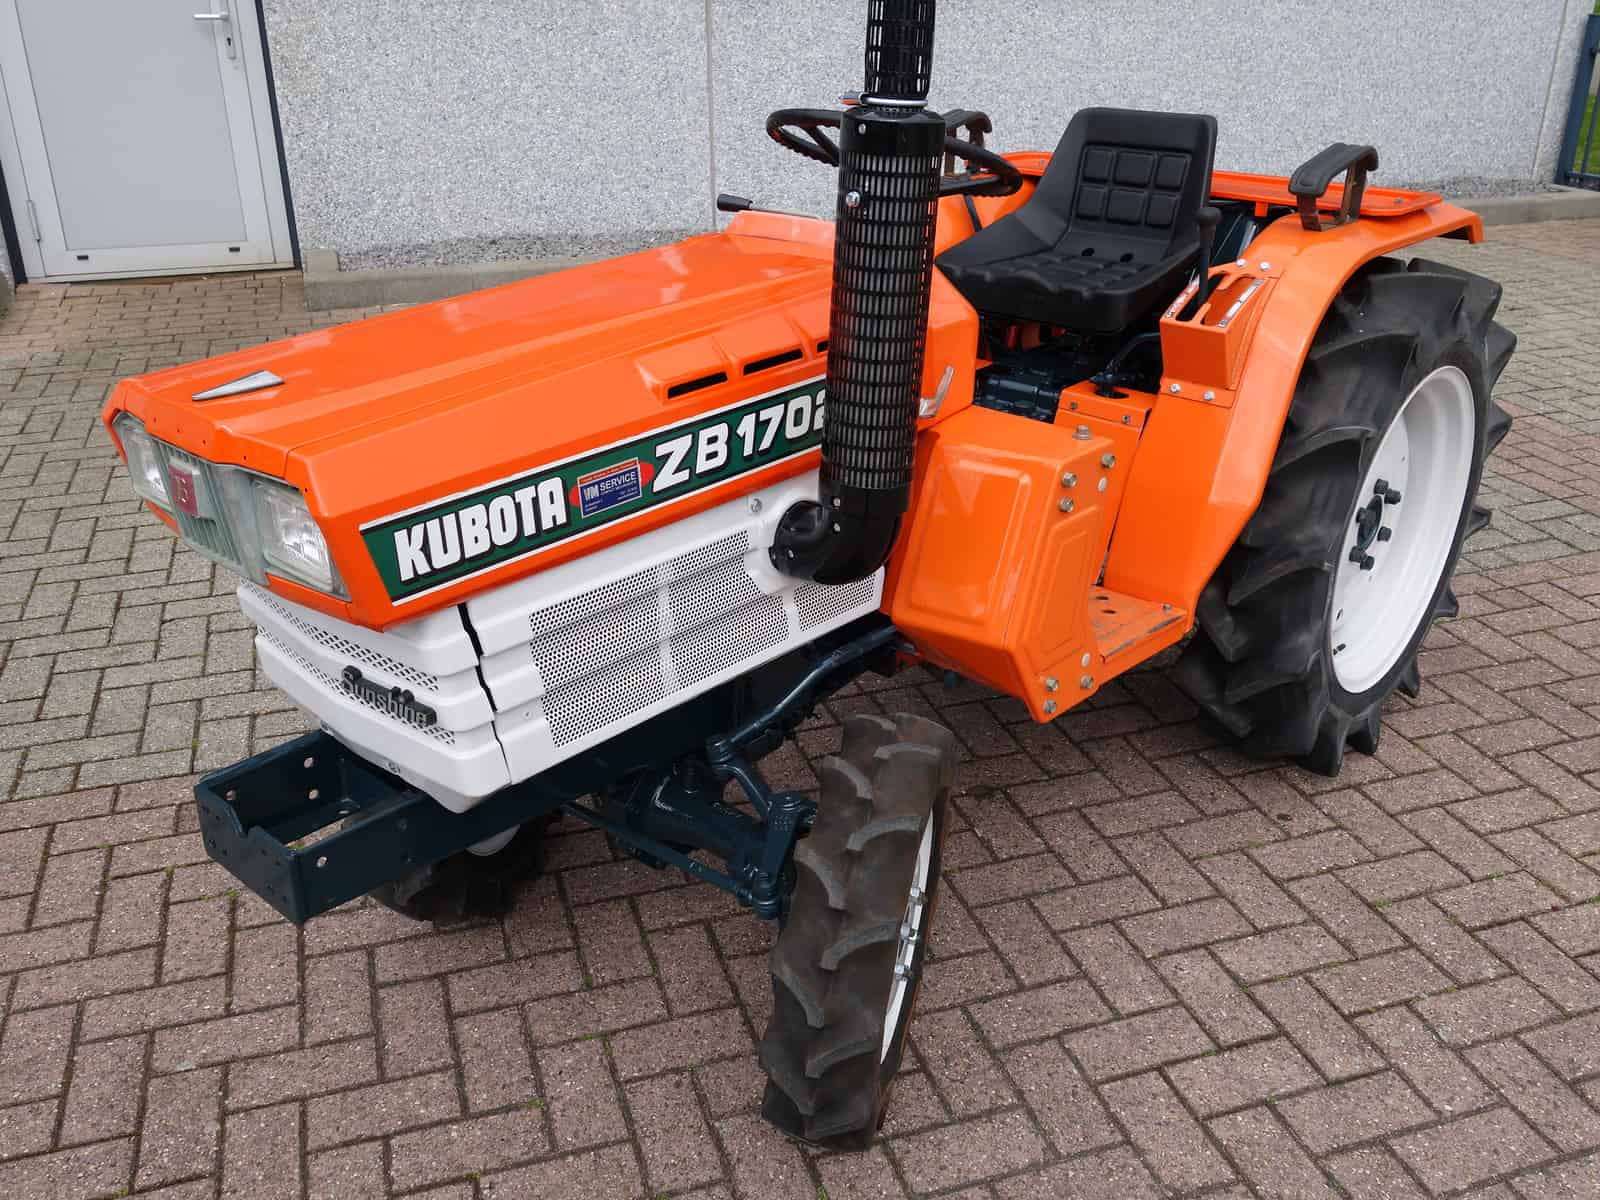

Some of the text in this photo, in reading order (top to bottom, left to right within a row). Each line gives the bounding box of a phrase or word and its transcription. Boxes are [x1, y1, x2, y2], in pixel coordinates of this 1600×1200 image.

[600, 471, 637, 491] SERVICE
[393, 476, 568, 582] KUBOTA
[340, 669, 428, 728] Sunshine
